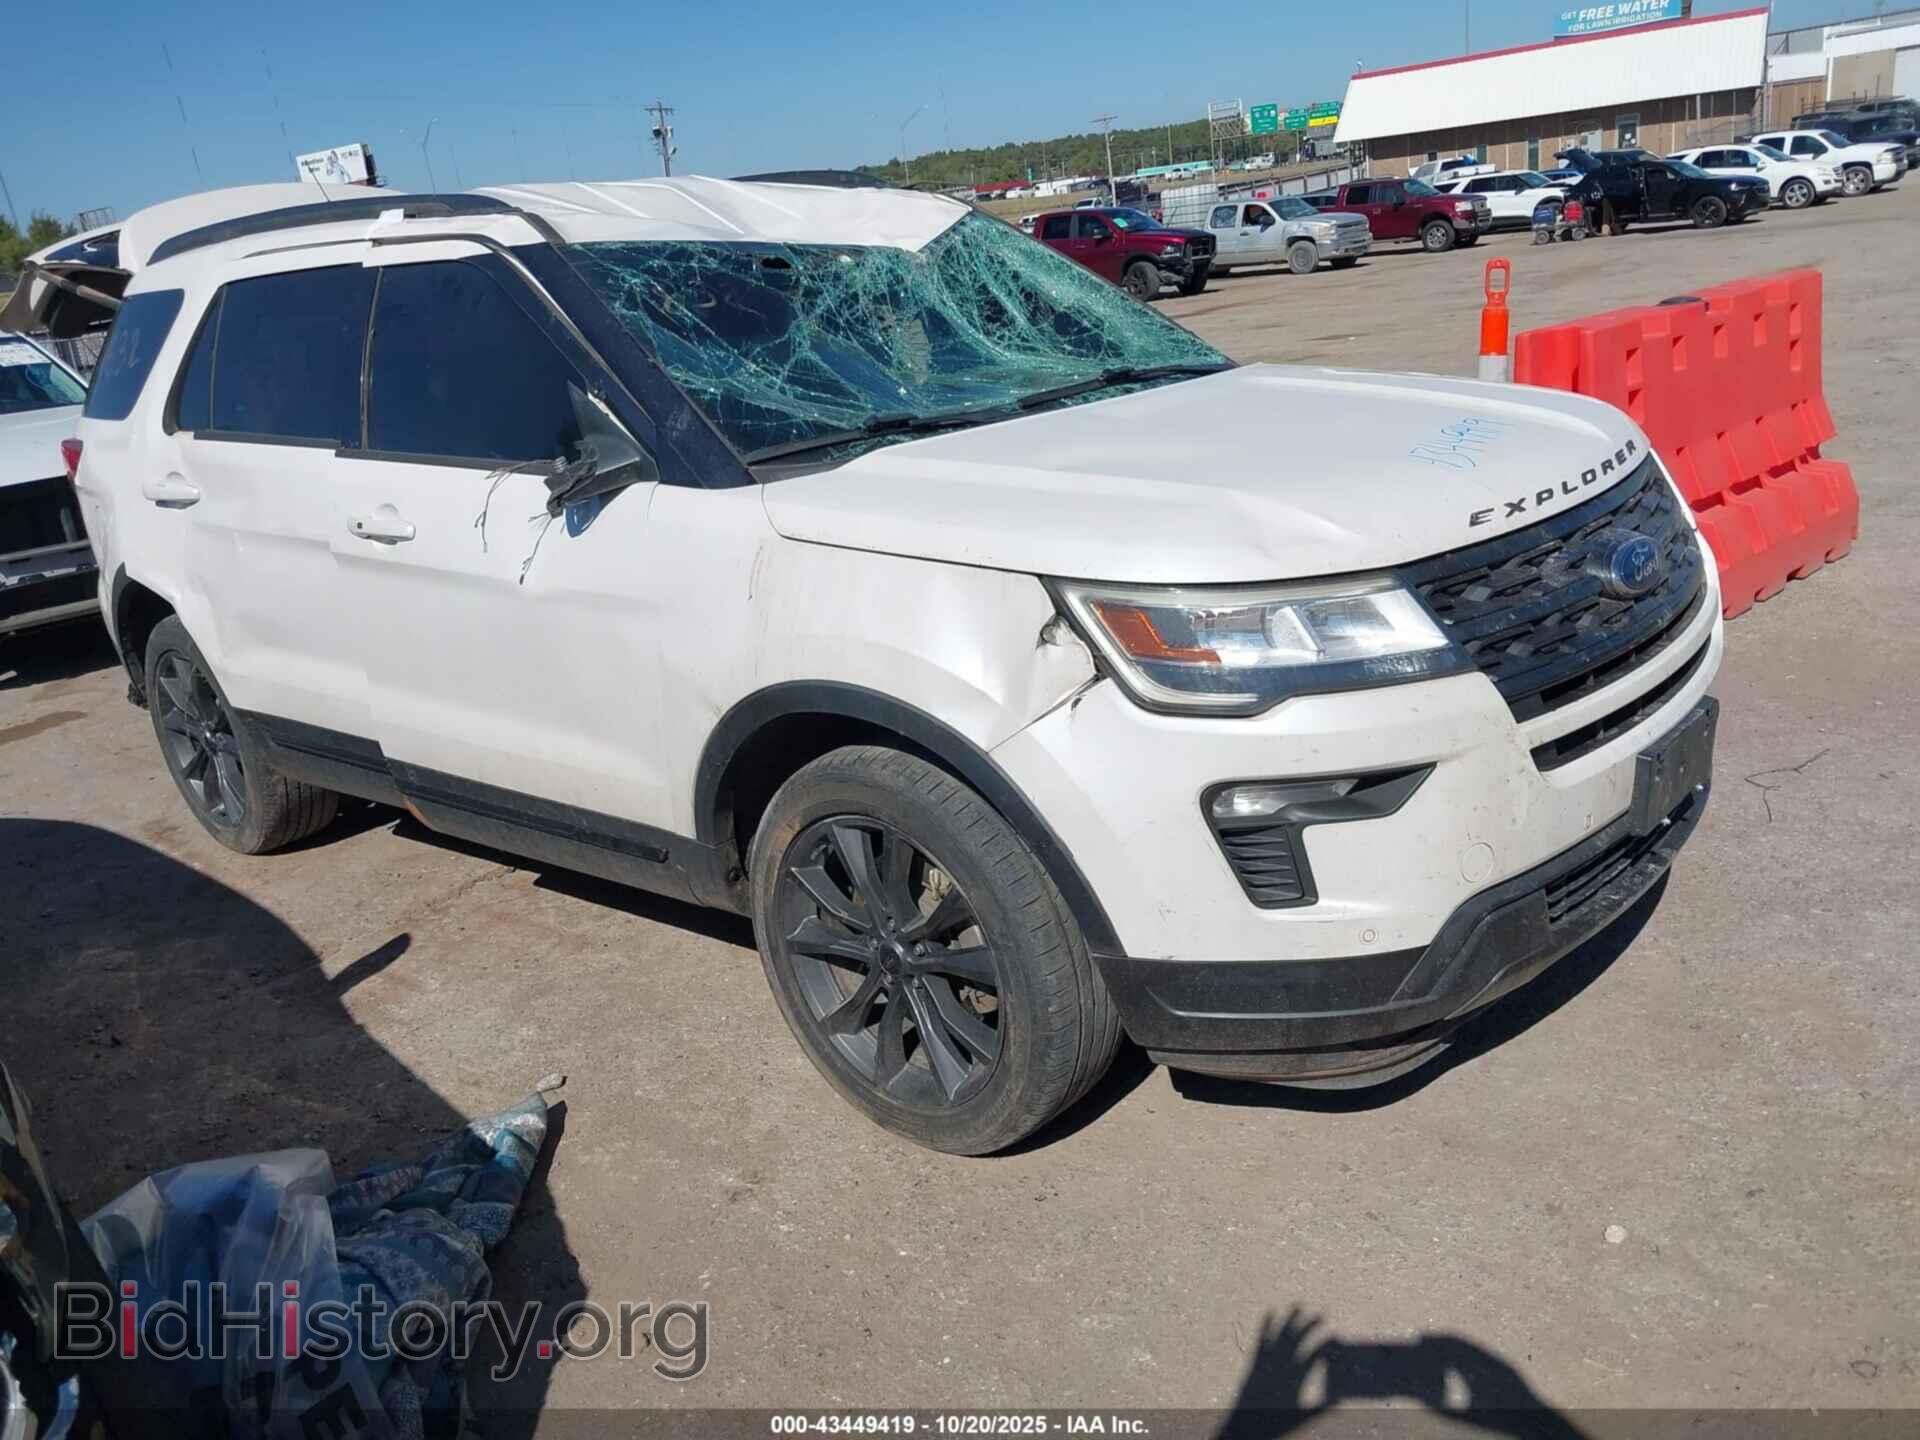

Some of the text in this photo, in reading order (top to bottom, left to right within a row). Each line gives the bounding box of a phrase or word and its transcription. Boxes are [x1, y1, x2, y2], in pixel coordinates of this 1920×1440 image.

[1561, 0, 1669, 22] GET FREE WATER
[1567, 12, 1663, 32] FOR LAWN IRRIGATION
[1468, 439, 1637, 528] EXPLORER
[1631, 545, 1661, 581] Ford
